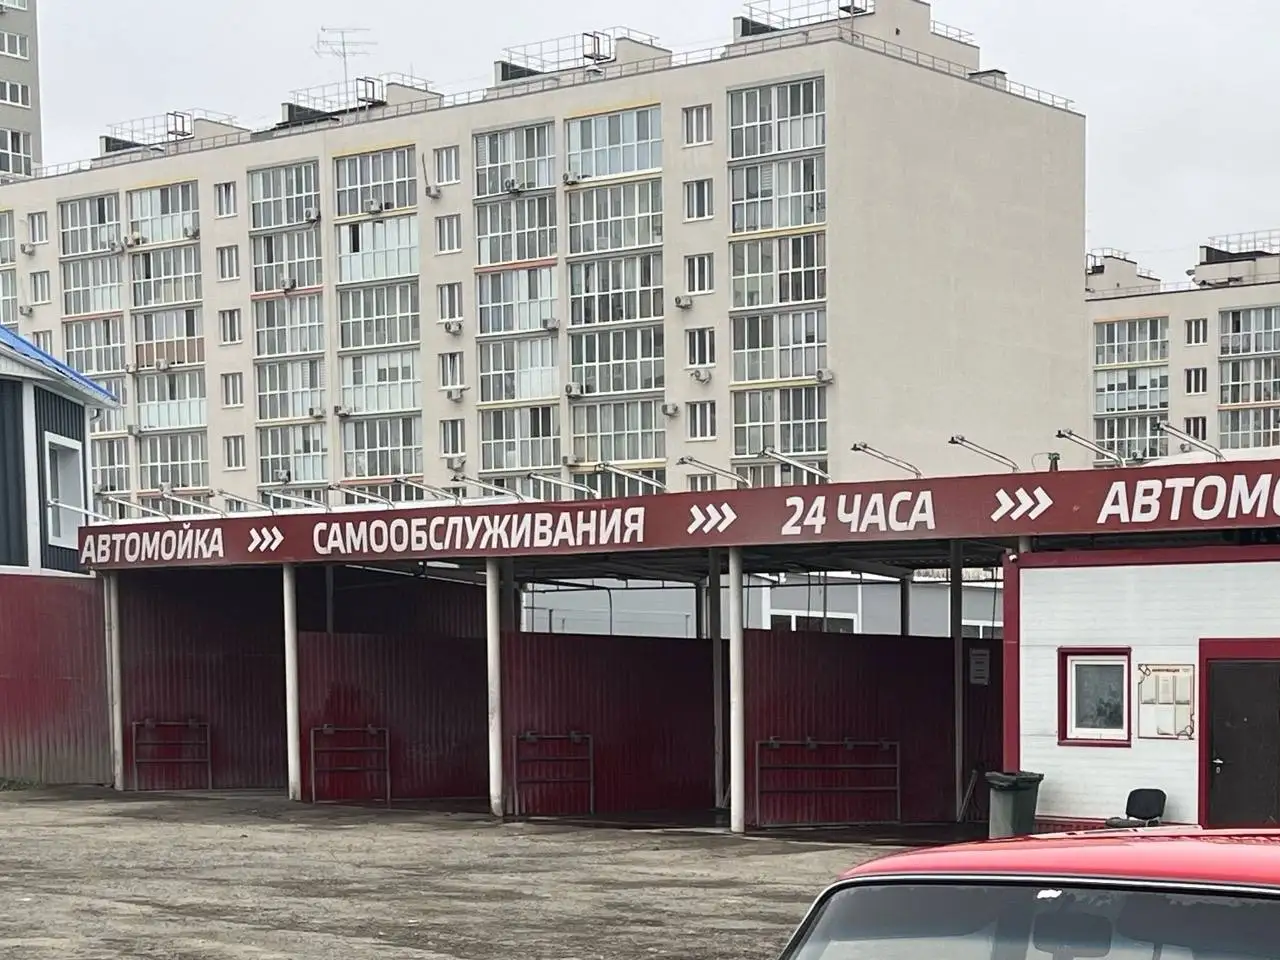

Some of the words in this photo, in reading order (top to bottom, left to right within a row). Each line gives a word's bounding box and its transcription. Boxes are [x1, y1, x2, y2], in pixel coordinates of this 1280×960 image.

[313, 507, 645, 554] САМООБСЛУЖИВАНИЯ
[781, 496, 827, 535] 24
[837, 491, 936, 532] ЧАСА
[80, 524, 224, 564] АВТОМОЙКА
